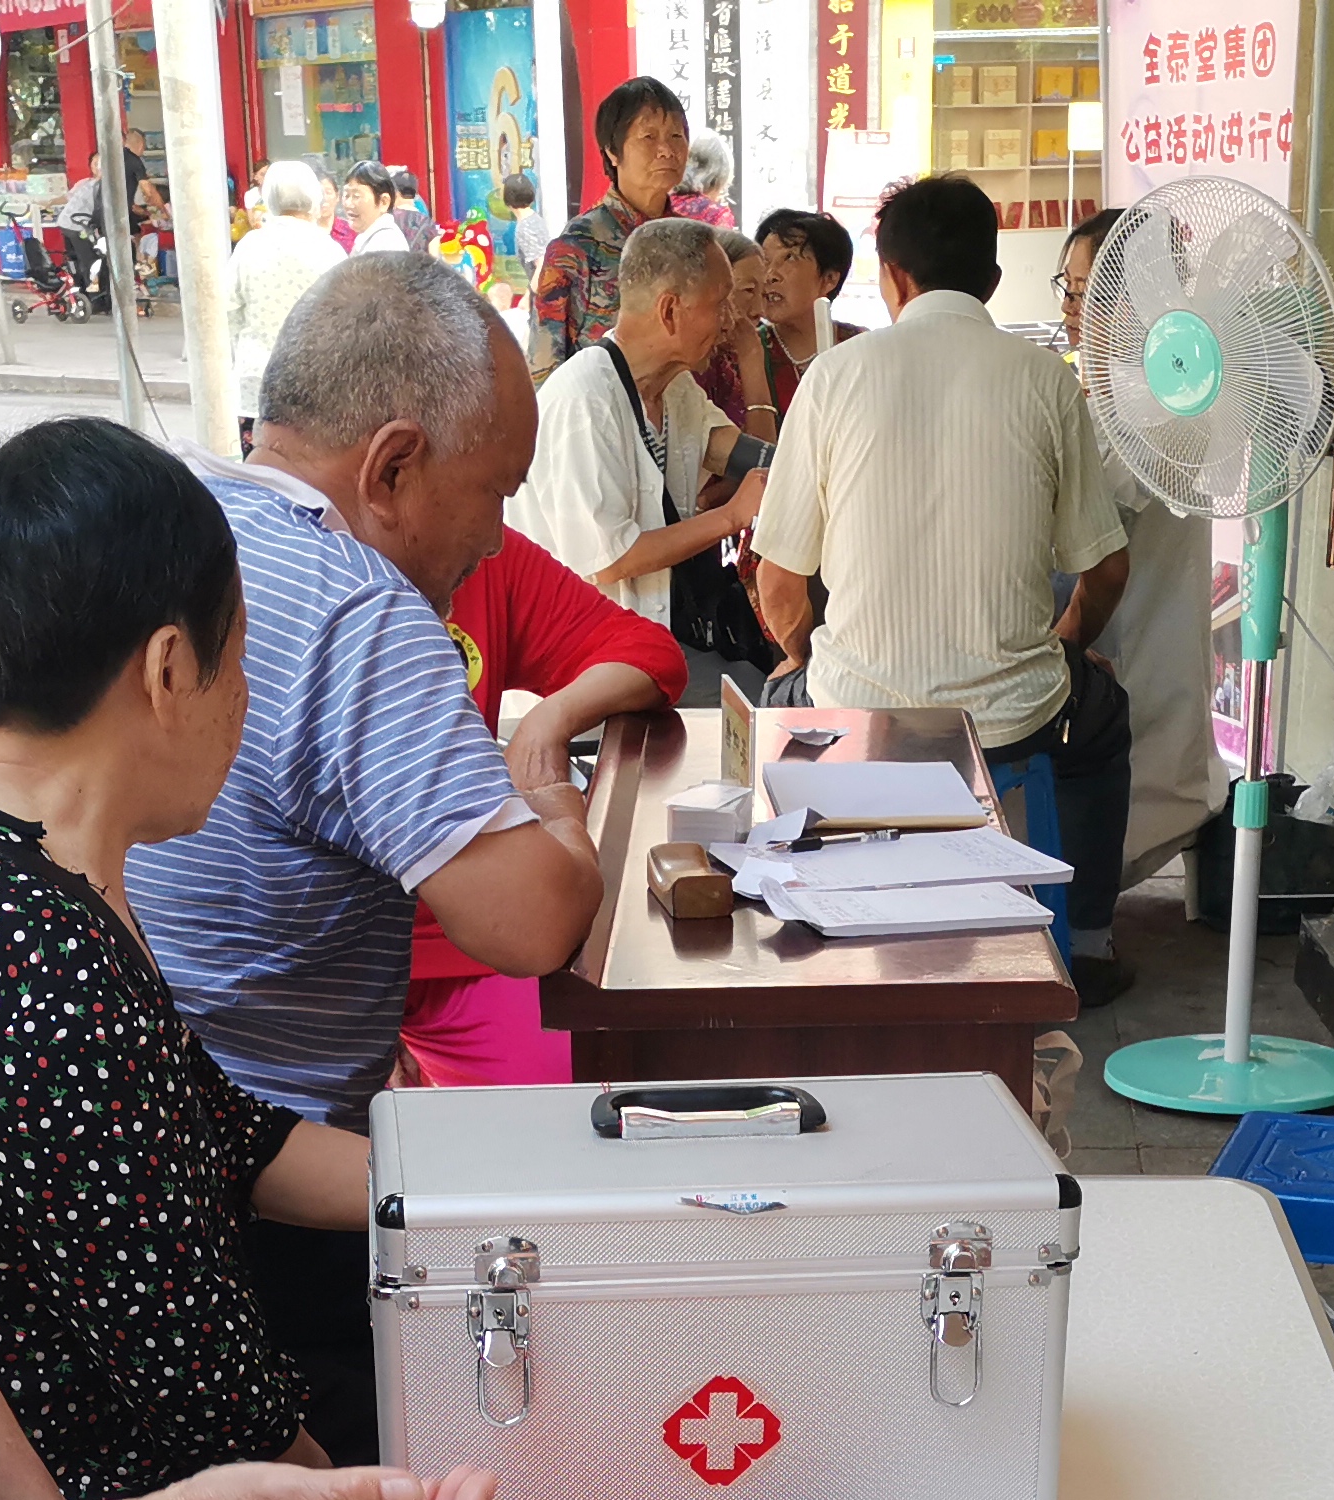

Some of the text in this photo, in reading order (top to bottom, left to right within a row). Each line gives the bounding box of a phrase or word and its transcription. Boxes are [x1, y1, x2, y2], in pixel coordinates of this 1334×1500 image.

[1143, 21, 1276, 86] 全泰堂集团
[1120, 108, 1293, 165] 公益活动进行中
